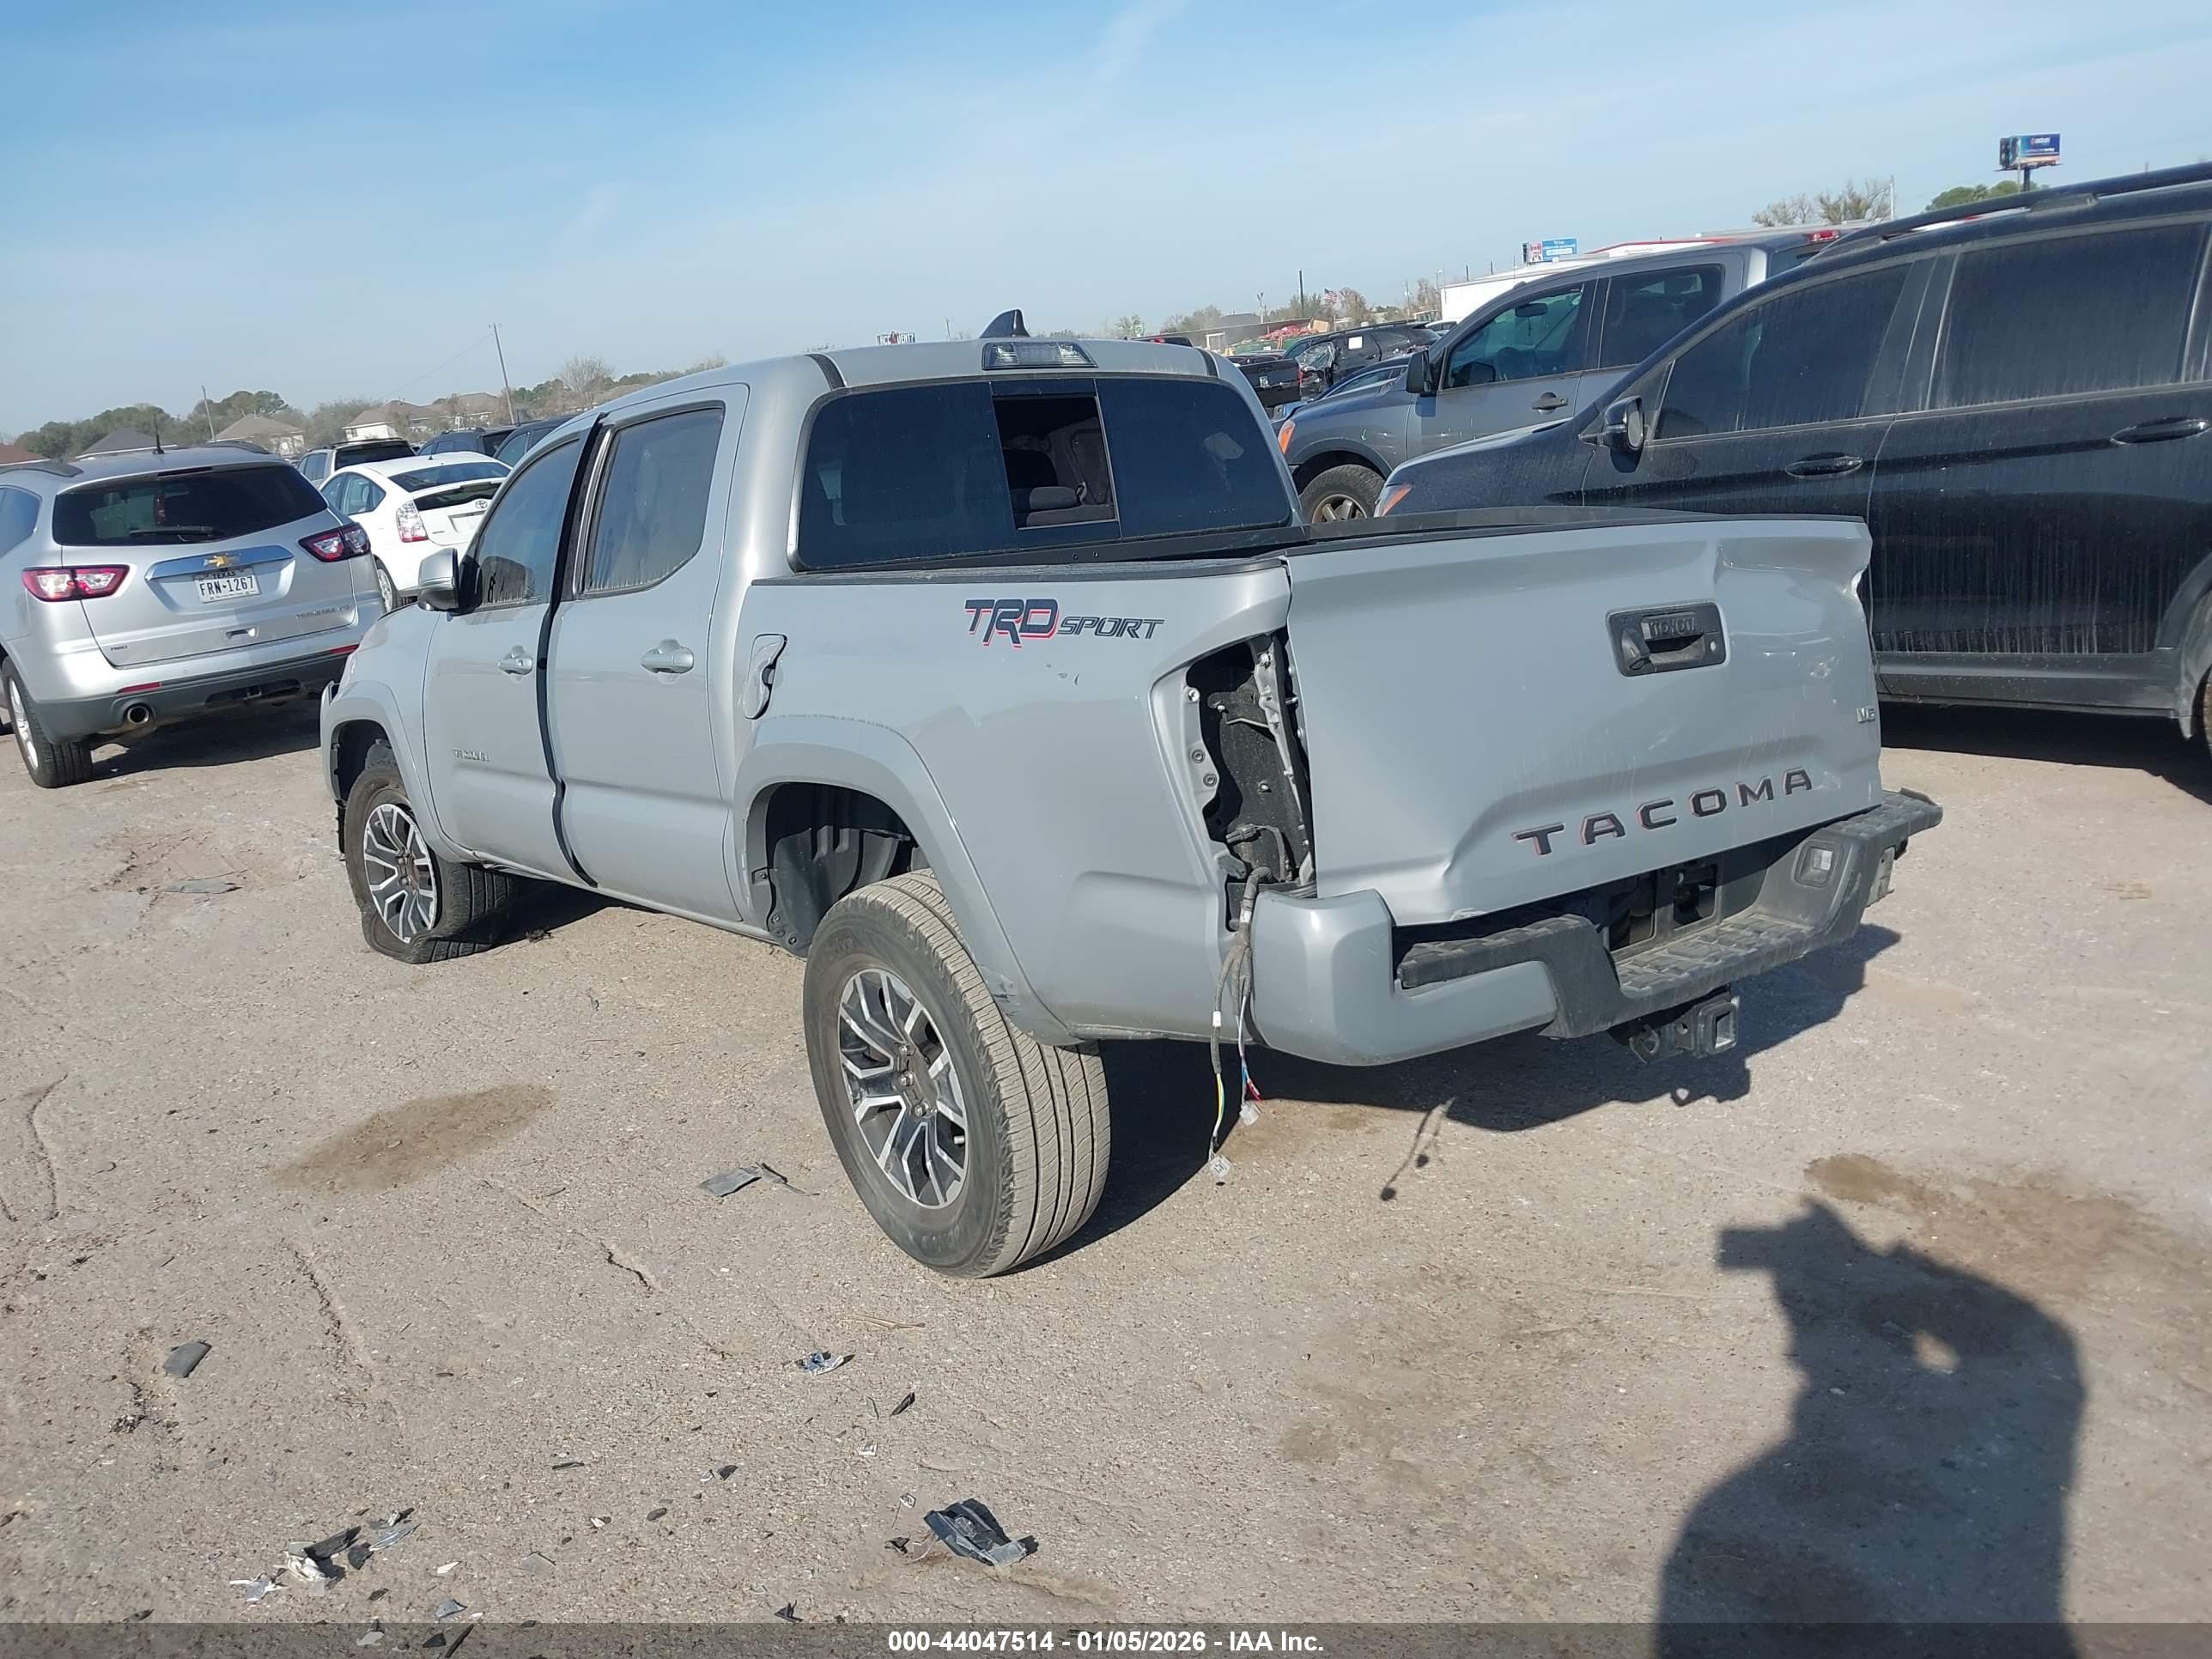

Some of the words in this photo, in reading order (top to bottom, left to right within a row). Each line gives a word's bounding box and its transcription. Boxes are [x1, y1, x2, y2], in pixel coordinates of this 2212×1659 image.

[213, 570, 236, 579] TEXAS
[965, 599, 1060, 648] TRD
[1057, 616, 1165, 640] SPORT
[1511, 767, 1813, 856] TACOMA
